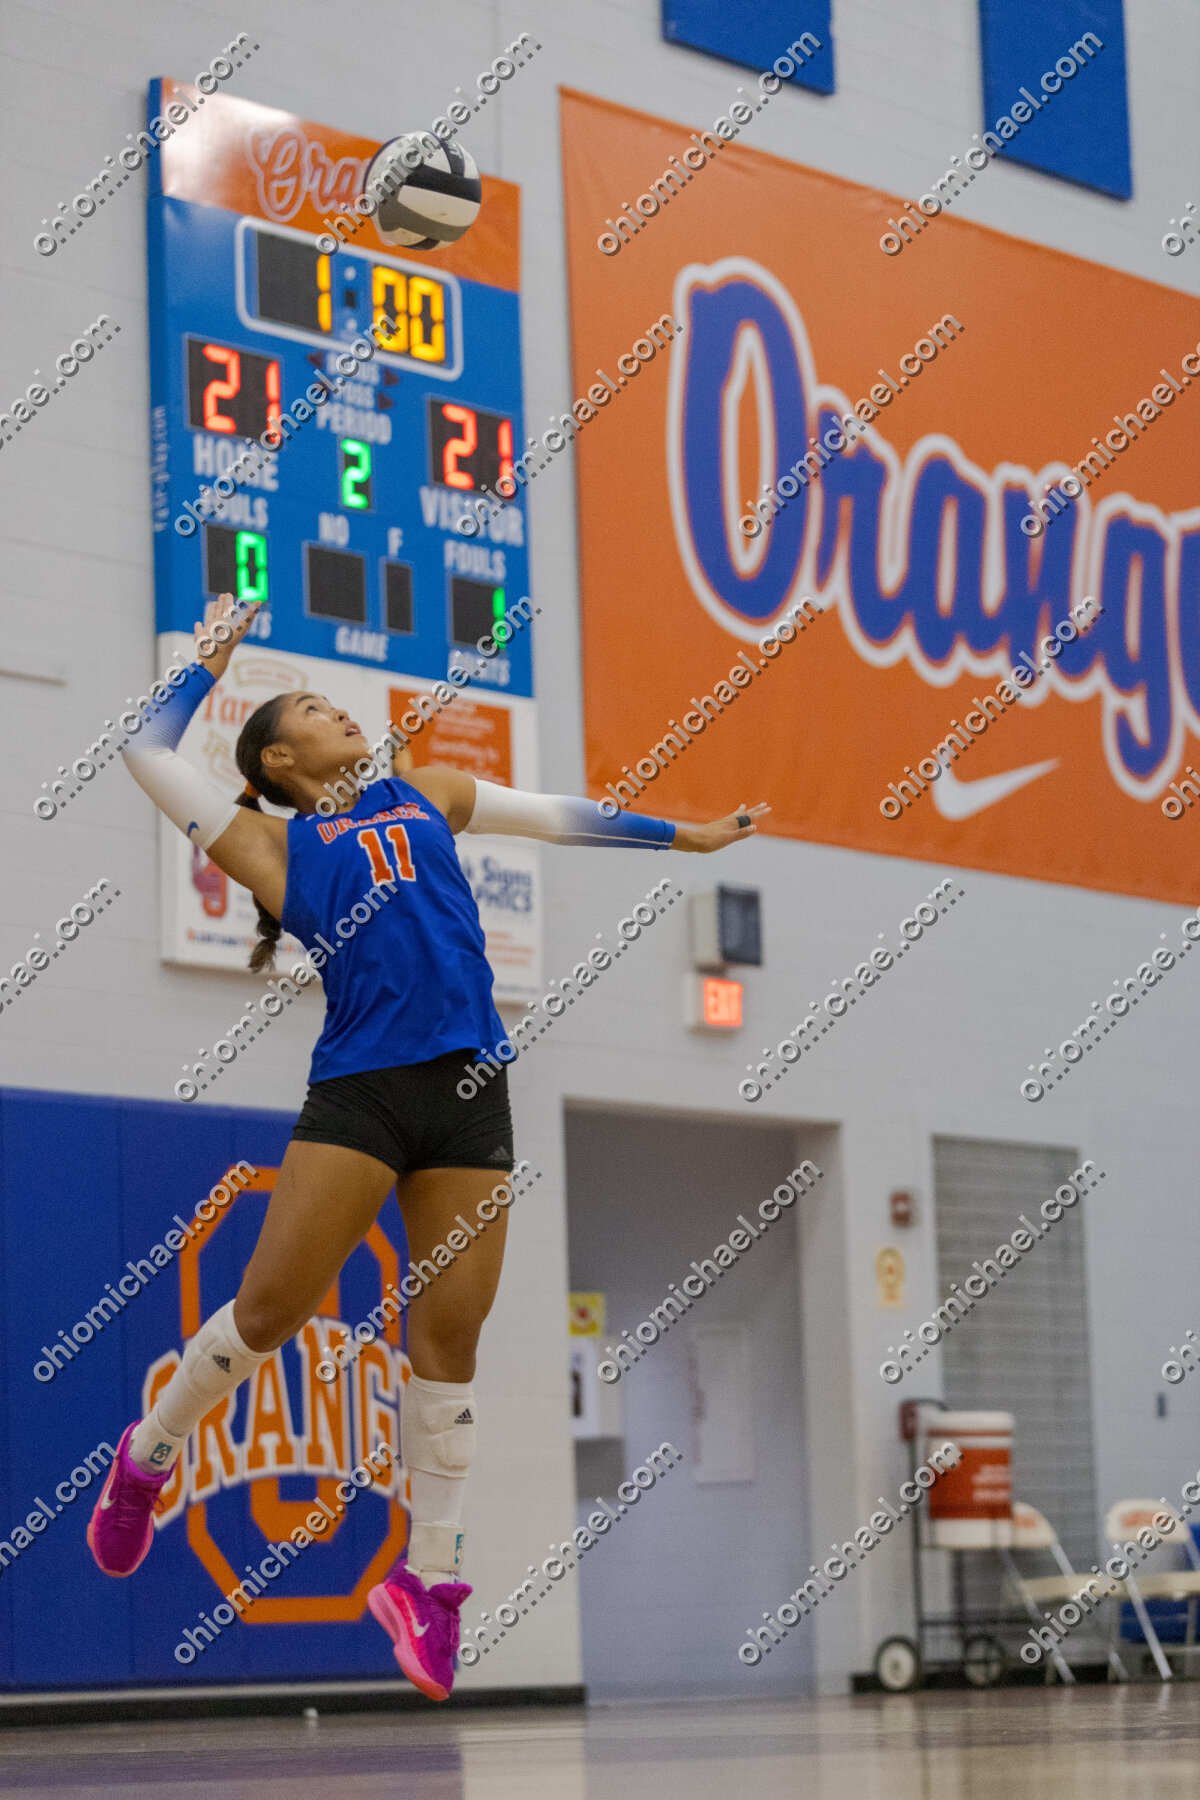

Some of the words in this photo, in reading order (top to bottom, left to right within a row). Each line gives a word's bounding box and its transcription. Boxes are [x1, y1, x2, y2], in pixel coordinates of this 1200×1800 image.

[202, 344, 281, 444] 21
[316, 402, 392, 445] PERIOD
[193, 434, 279, 492] HOME
[341, 438, 371, 509] 2
[441, 403, 513, 498] 21
[388, 527, 403, 556] F
[444, 539, 506, 581] FOULS
[666, 256, 1200, 802] Orang
[236, 531, 268, 602] 0
[334, 626, 390, 662] GAME
[357, 824, 416, 887] 11
[142, 1317, 412, 1531] ORANG
